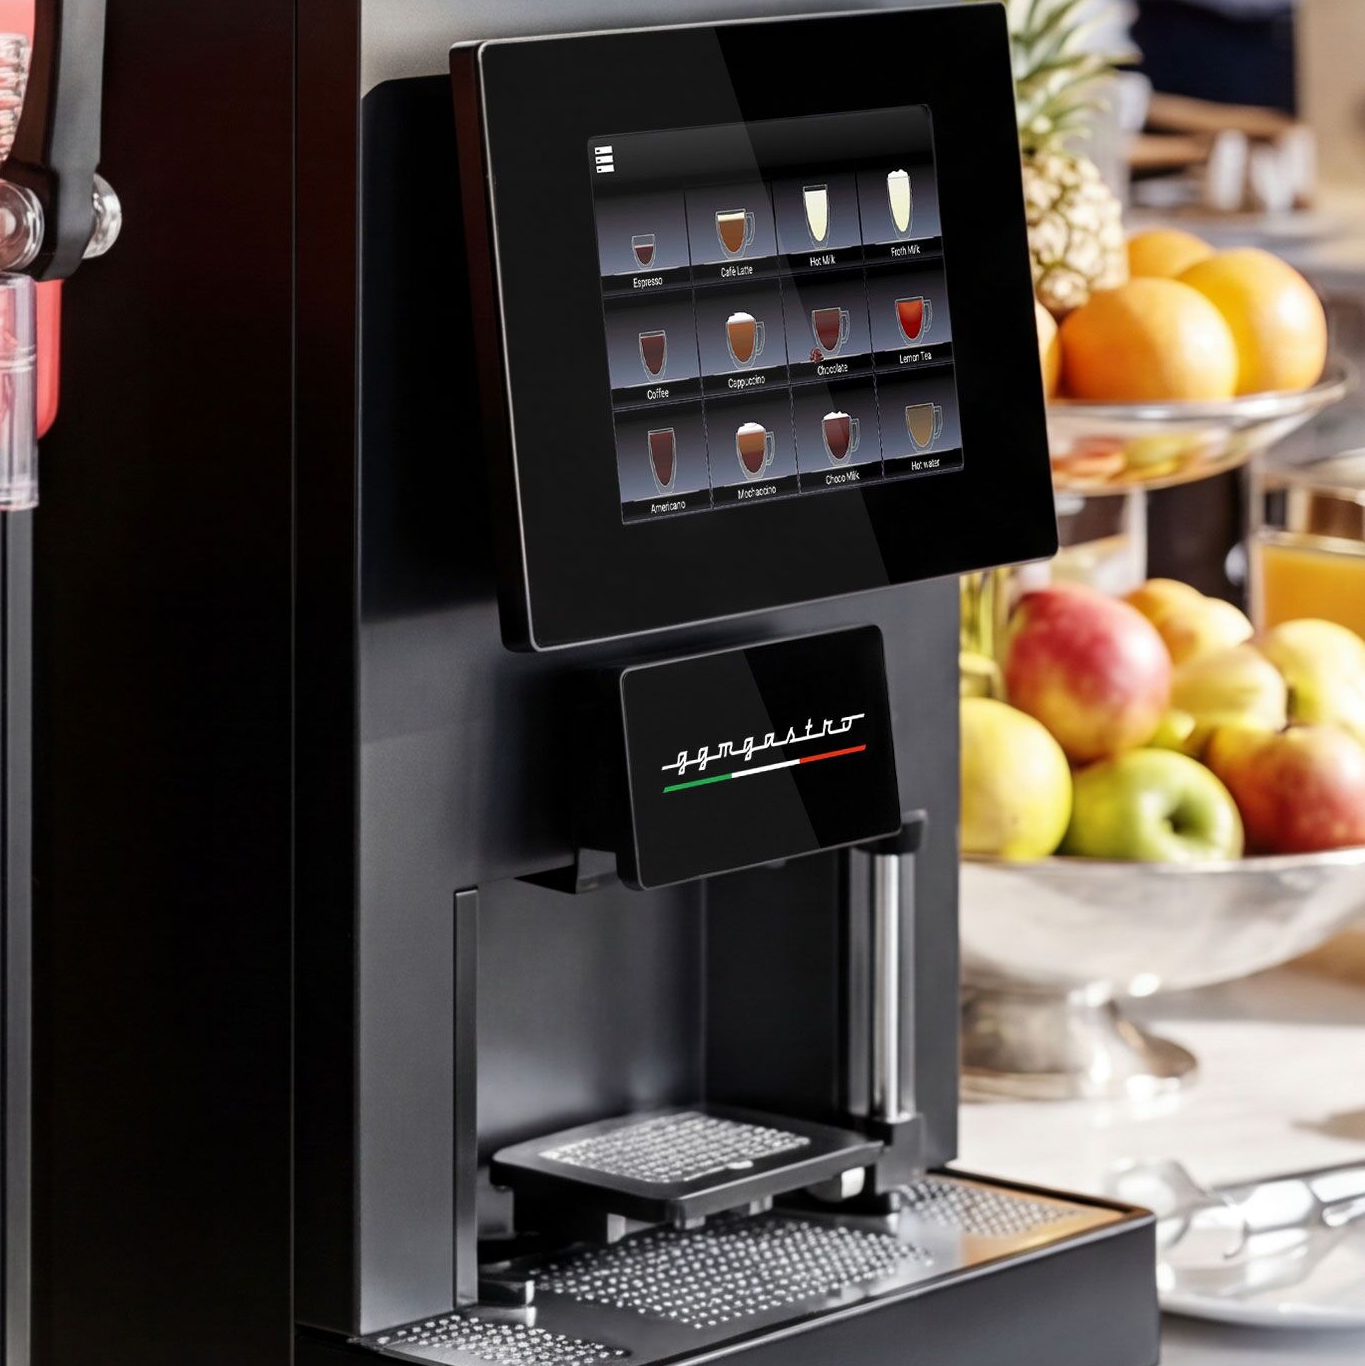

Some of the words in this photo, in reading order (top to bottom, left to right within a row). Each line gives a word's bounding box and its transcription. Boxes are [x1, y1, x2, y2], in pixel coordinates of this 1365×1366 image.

[809, 256, 822, 267] Hot
[736, 266, 753, 276] Latte
[633, 276, 663, 289] Espresso
[899, 353, 919, 364] Lemon
[920, 351, 932, 361] Tea
[817, 363, 848, 376] Chocolate
[728, 375, 766, 390] Cappuccino
[647, 387, 670, 400] Coffee
[911, 461, 923, 471] Hot
[846, 470, 860, 482] Milk
[651, 500, 686, 514] Americano
